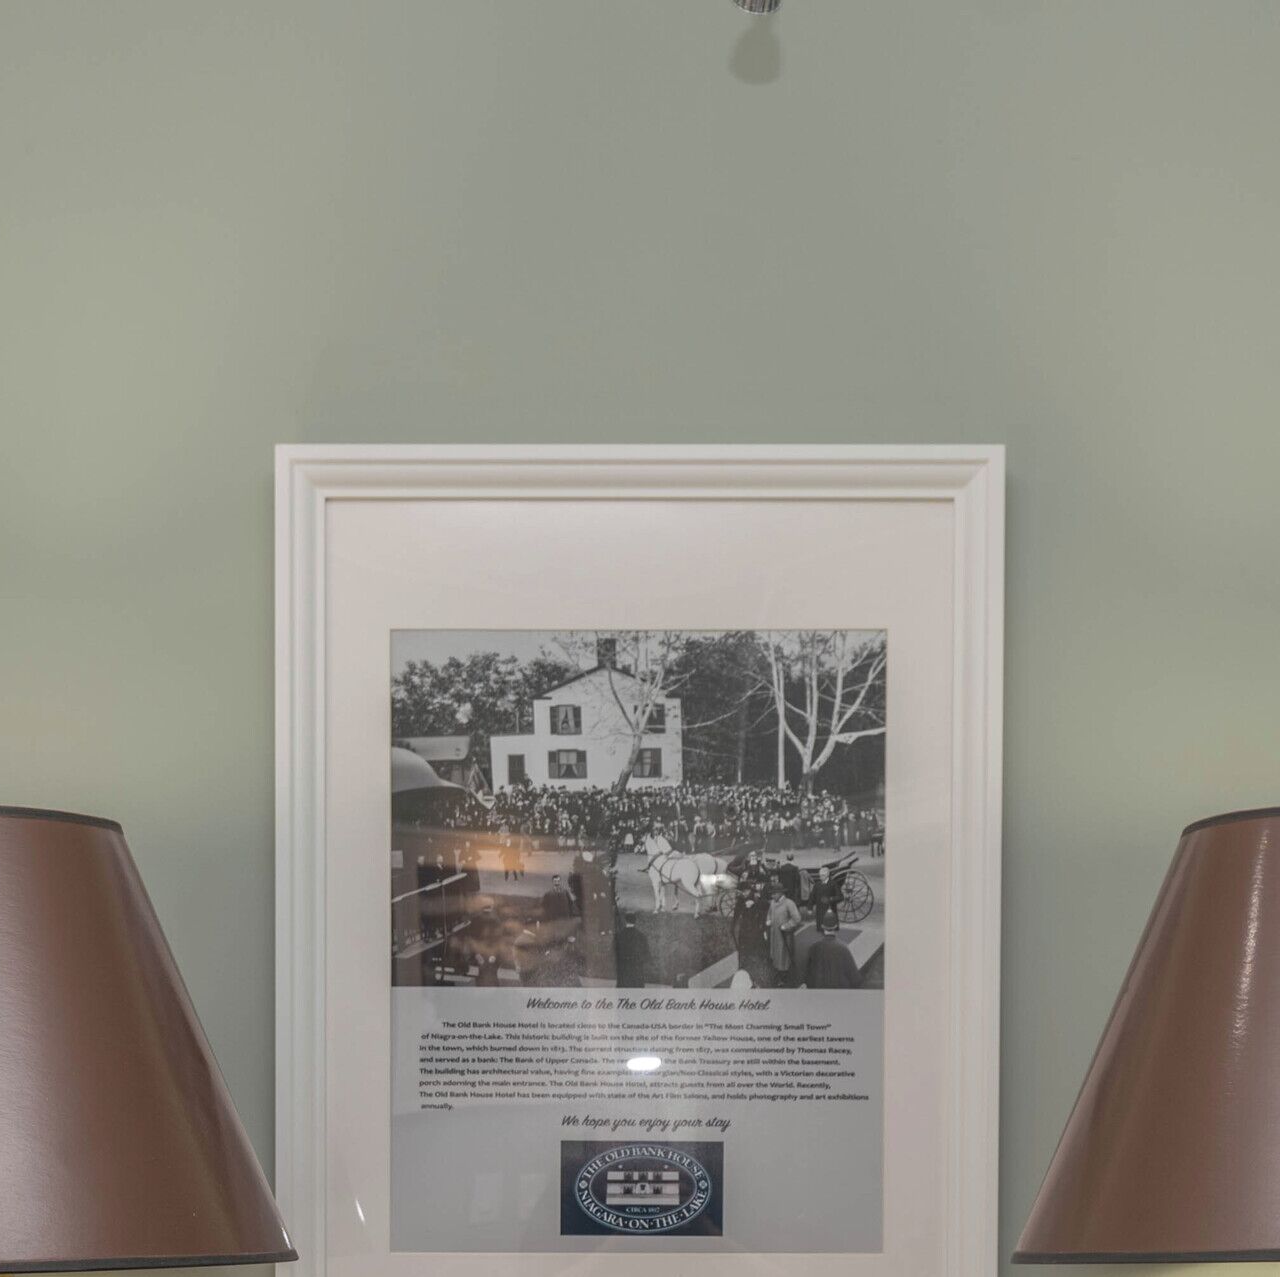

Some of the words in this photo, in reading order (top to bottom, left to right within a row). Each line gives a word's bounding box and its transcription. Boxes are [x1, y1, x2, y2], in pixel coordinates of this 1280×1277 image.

[527, 998, 578, 1009] Welcome
[581, 999, 591, 1009] to
[595, 999, 613, 1009] the
[617, 999, 636, 1009] The
[641, 999, 660, 1009] Old
[666, 999, 695, 1009] Bank
[700, 999, 734, 1009] House
[552, 1034, 581, 1042] building
[749, 1093, 797, 1101] photography
[561, 1116, 579, 1126] We
[582, 1116, 609, 1131] hope
[611, 1119, 636, 1132] you
[640, 1118, 669, 1132] enjoy
[672, 1119, 702, 1132] your
[706, 1117, 731, 1132] stay
[582, 1157, 608, 1179] THE
[606, 1148, 630, 1162] OLD
[632, 1146, 666, 1158] BANK
[668, 1151, 704, 1180] HOUSE
